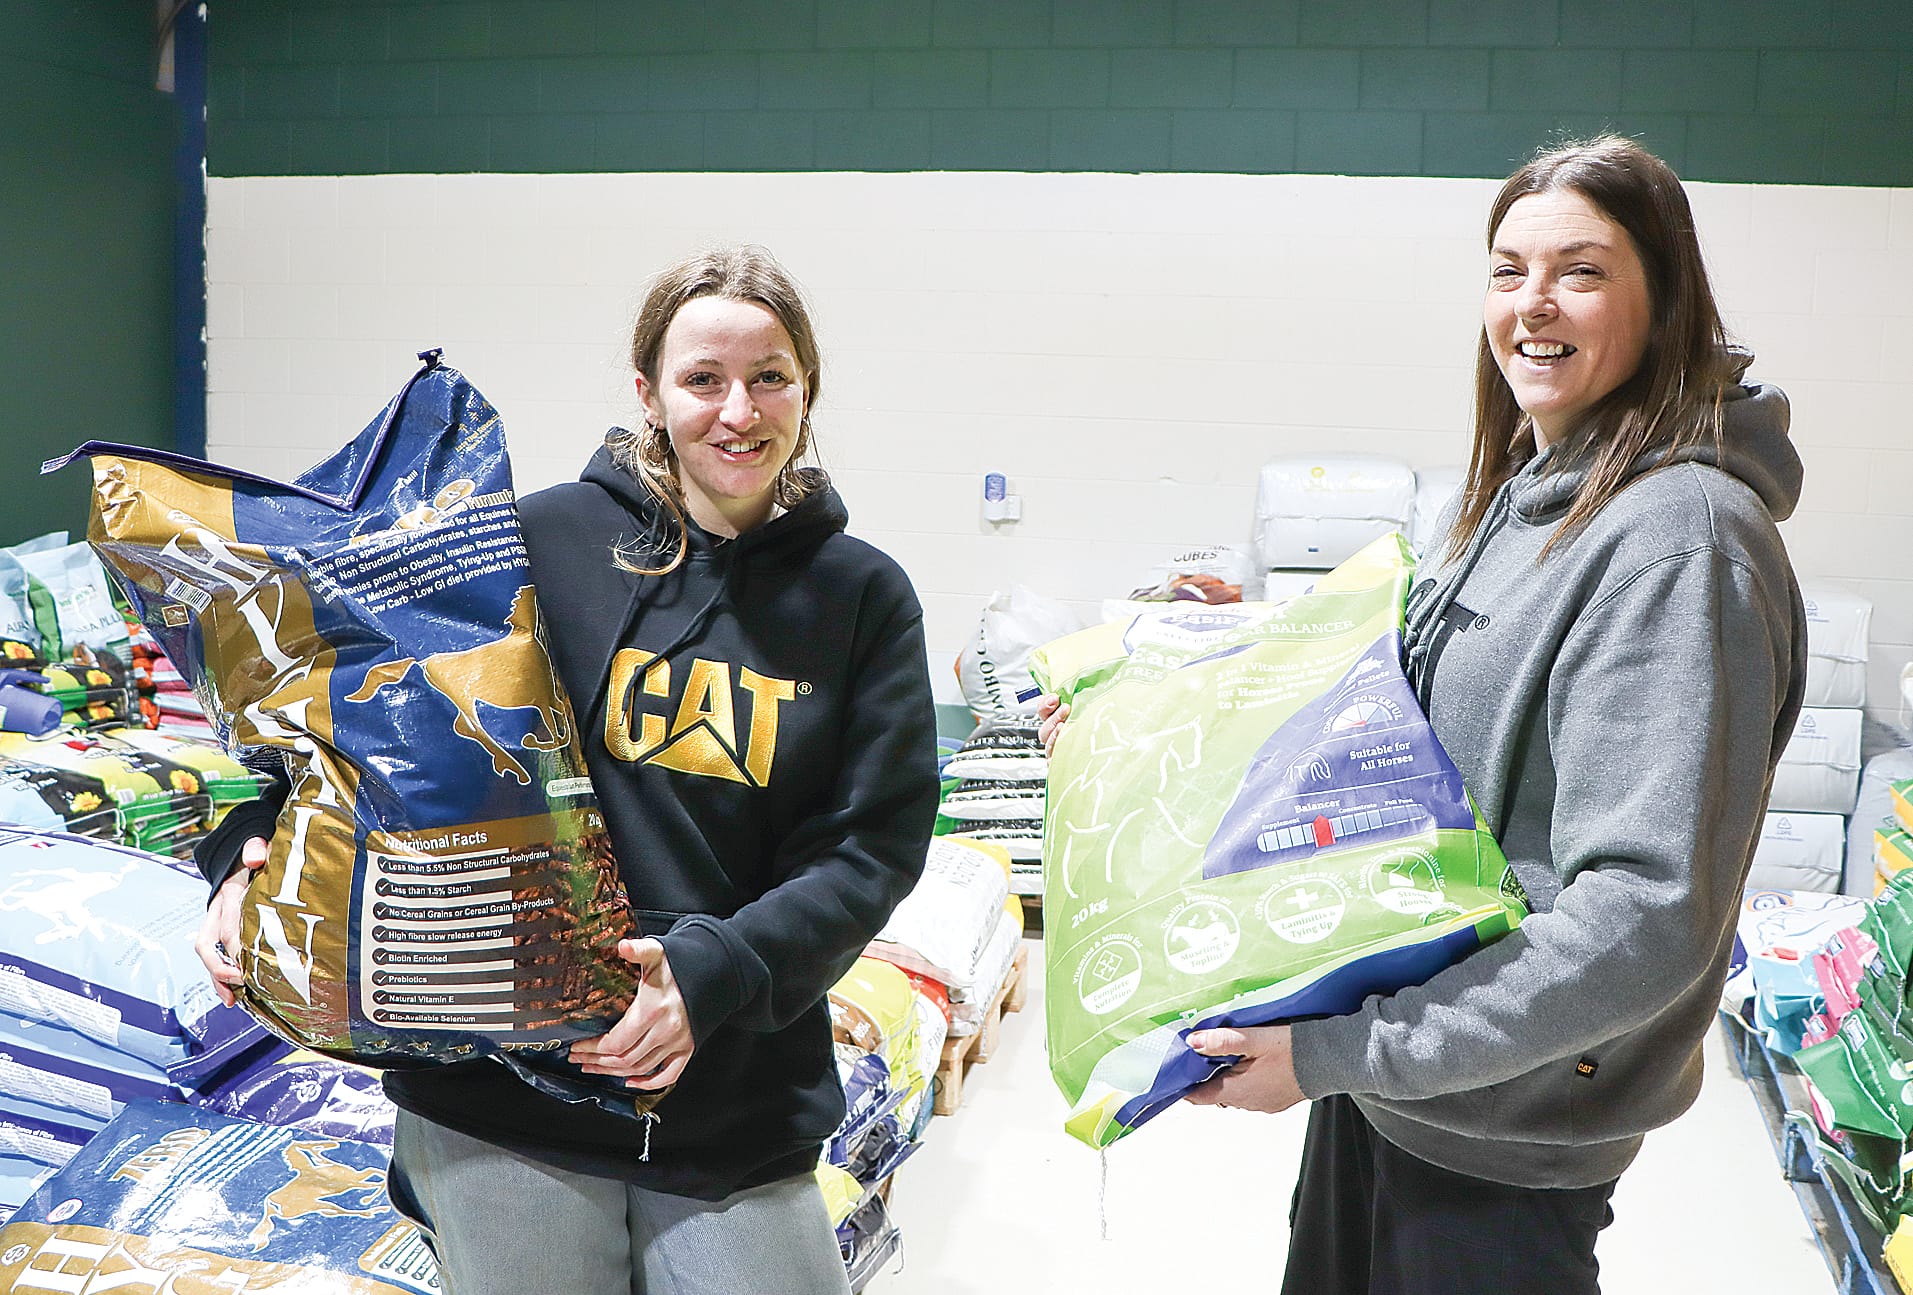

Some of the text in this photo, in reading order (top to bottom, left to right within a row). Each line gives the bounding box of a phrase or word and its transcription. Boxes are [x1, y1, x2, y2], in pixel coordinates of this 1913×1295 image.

[469, 512, 479, 524] all
[479, 508, 510, 523] Equines
[339, 567, 359, 581] Non
[358, 551, 402, 573] Structural
[402, 529, 468, 556] Carbohydrates,
[468, 523, 501, 536] starches
[366, 579, 410, 602] Metabolic
[409, 562, 458, 586] Syndrome,
[456, 550, 495, 569] Tying-Up
[496, 547, 511, 559] and
[373, 571, 399, 588] prone
[398, 565, 410, 577] to
[409, 552, 446, 573] Obesity,
[446, 543, 476, 559] Insulin
[386, 593, 409, 609] Carb
[414, 584, 434, 599] Low
[447, 573, 465, 586] diet
[464, 563, 501, 582] provided
[501, 559, 513, 571] by
[1268, 619, 1356, 635] BALANCER
[1249, 661, 1299, 673] Vitamin
[1352, 693, 1405, 721] POWERFUL
[603, 647, 797, 789] CAT
[1349, 740, 1412, 760] Suitable for
[1360, 753, 1415, 772] All Horses
[1293, 799, 1341, 814] Balancer
[384, 831, 489, 853] Nutritional Facts
[388, 848, 551, 873] Less than 5.5% Non Structural Carbohydrates
[390, 884, 473, 896] Less than 1.5% Starch
[388, 897, 556, 919] No Cereal Grains or Cereal Grain By-Products
[1071, 896, 1109, 929] 20 kg
[1280, 912, 1328, 931] Laminitis
[1290, 921, 1333, 939] Tying Up
[388, 928, 503, 942] High fibre slow release energy
[388, 952, 448, 964] Biotin Enriched
[388, 975, 428, 984] Prebiotics
[388, 995, 456, 1004] Natural Vitamin E
[389, 1013, 477, 1023] Bio-Available Selenium
[1577, 1062, 1595, 1074] CAT
